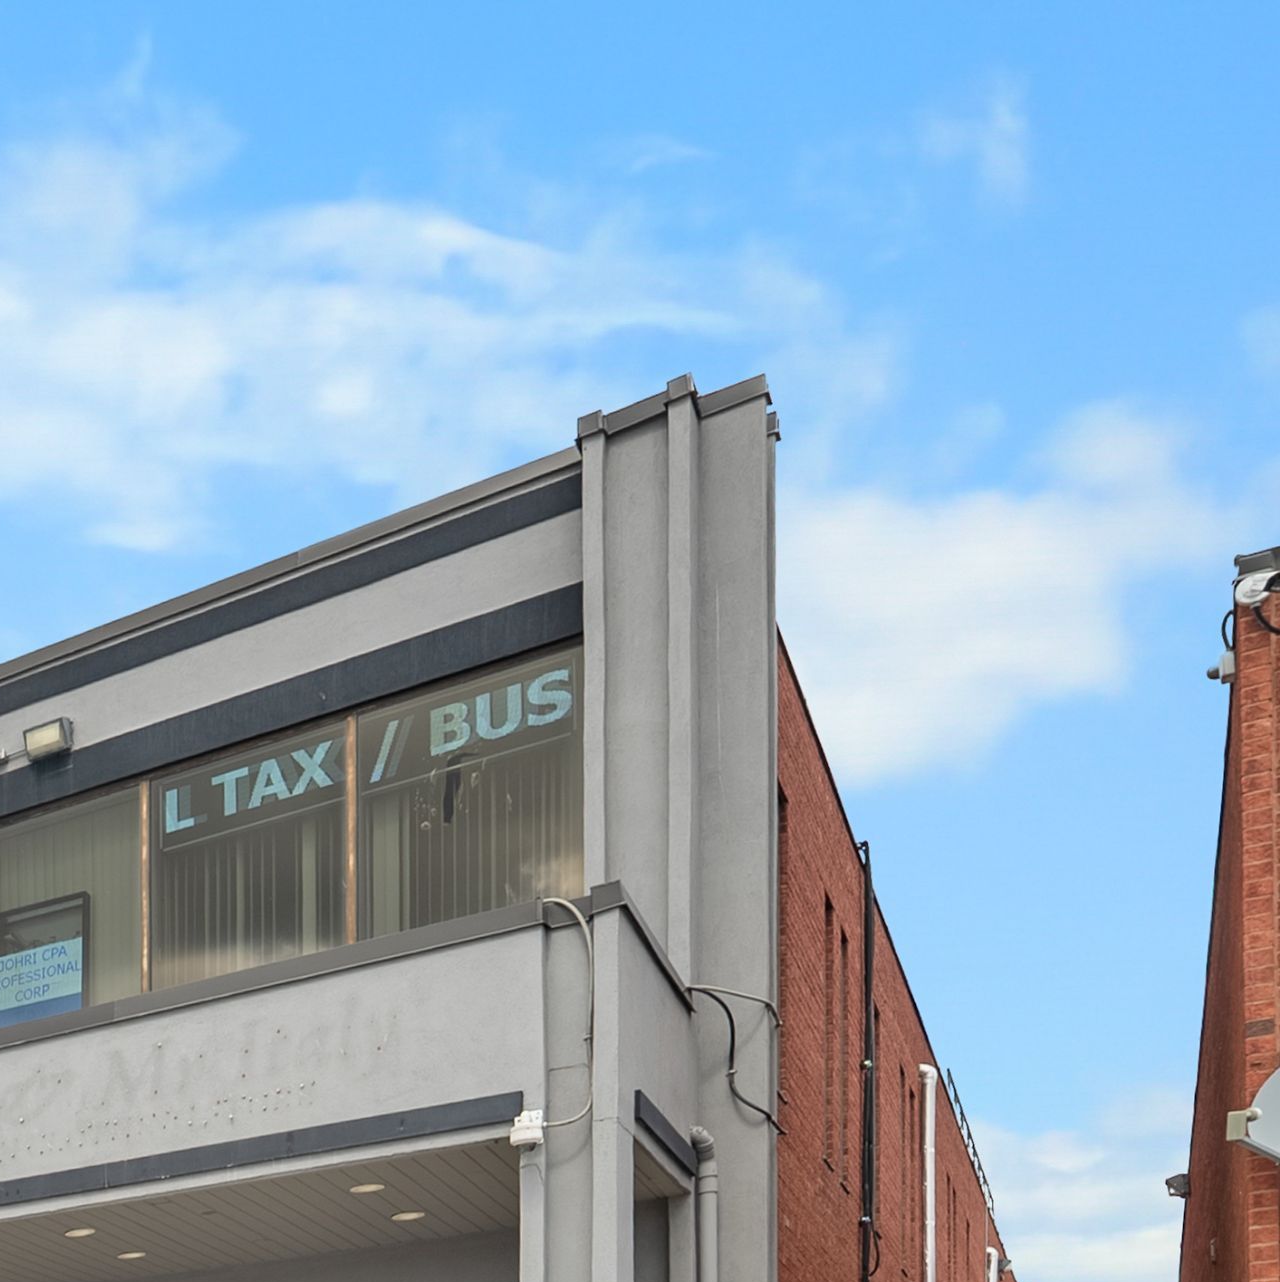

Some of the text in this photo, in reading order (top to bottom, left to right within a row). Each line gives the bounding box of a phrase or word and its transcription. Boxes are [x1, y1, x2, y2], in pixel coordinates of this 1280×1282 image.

[211, 740, 334, 817] TAX
[429, 667, 572, 758] BUS
[41, 944, 68, 962] CPA
[14, 983, 50, 1003] CORP
